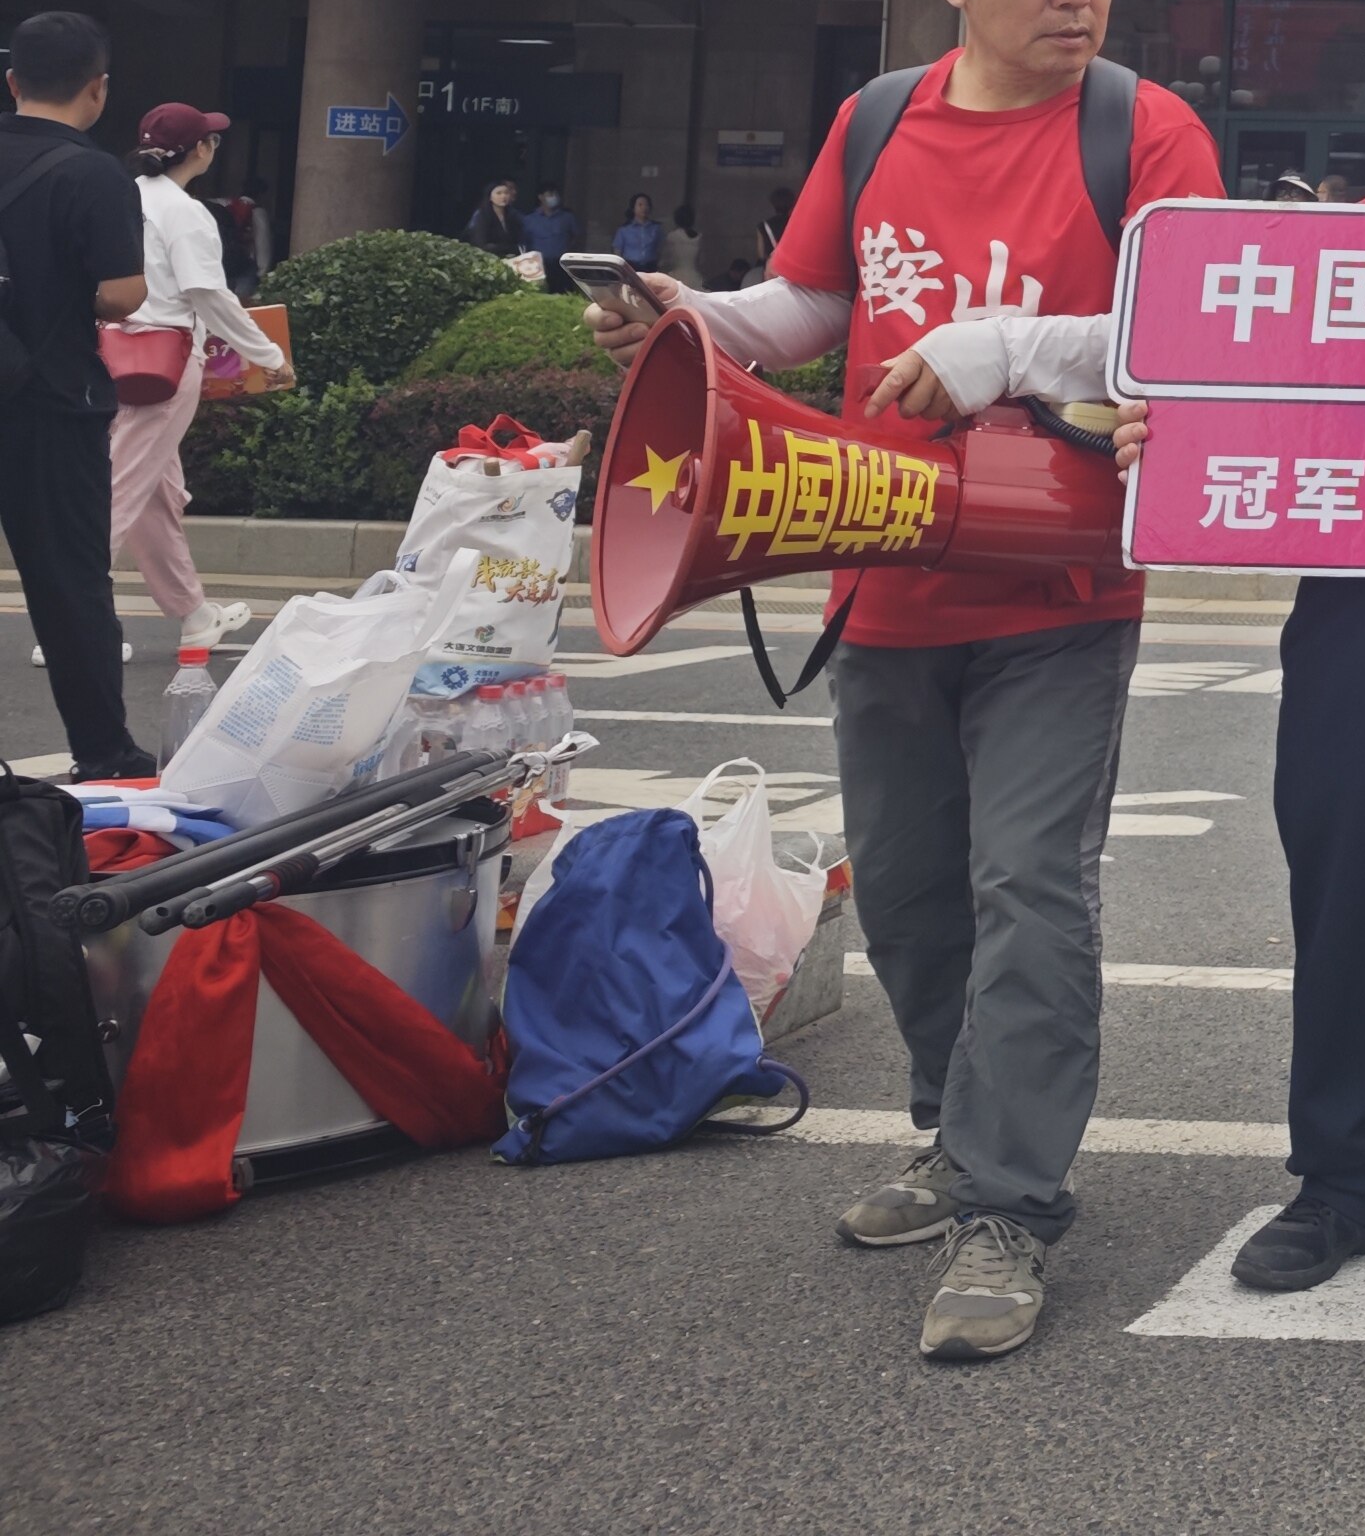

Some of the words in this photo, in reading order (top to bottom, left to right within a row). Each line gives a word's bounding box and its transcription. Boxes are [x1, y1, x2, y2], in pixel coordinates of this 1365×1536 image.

[334, 112, 401, 134] 进站口
[860, 221, 1044, 326] 鞍山
